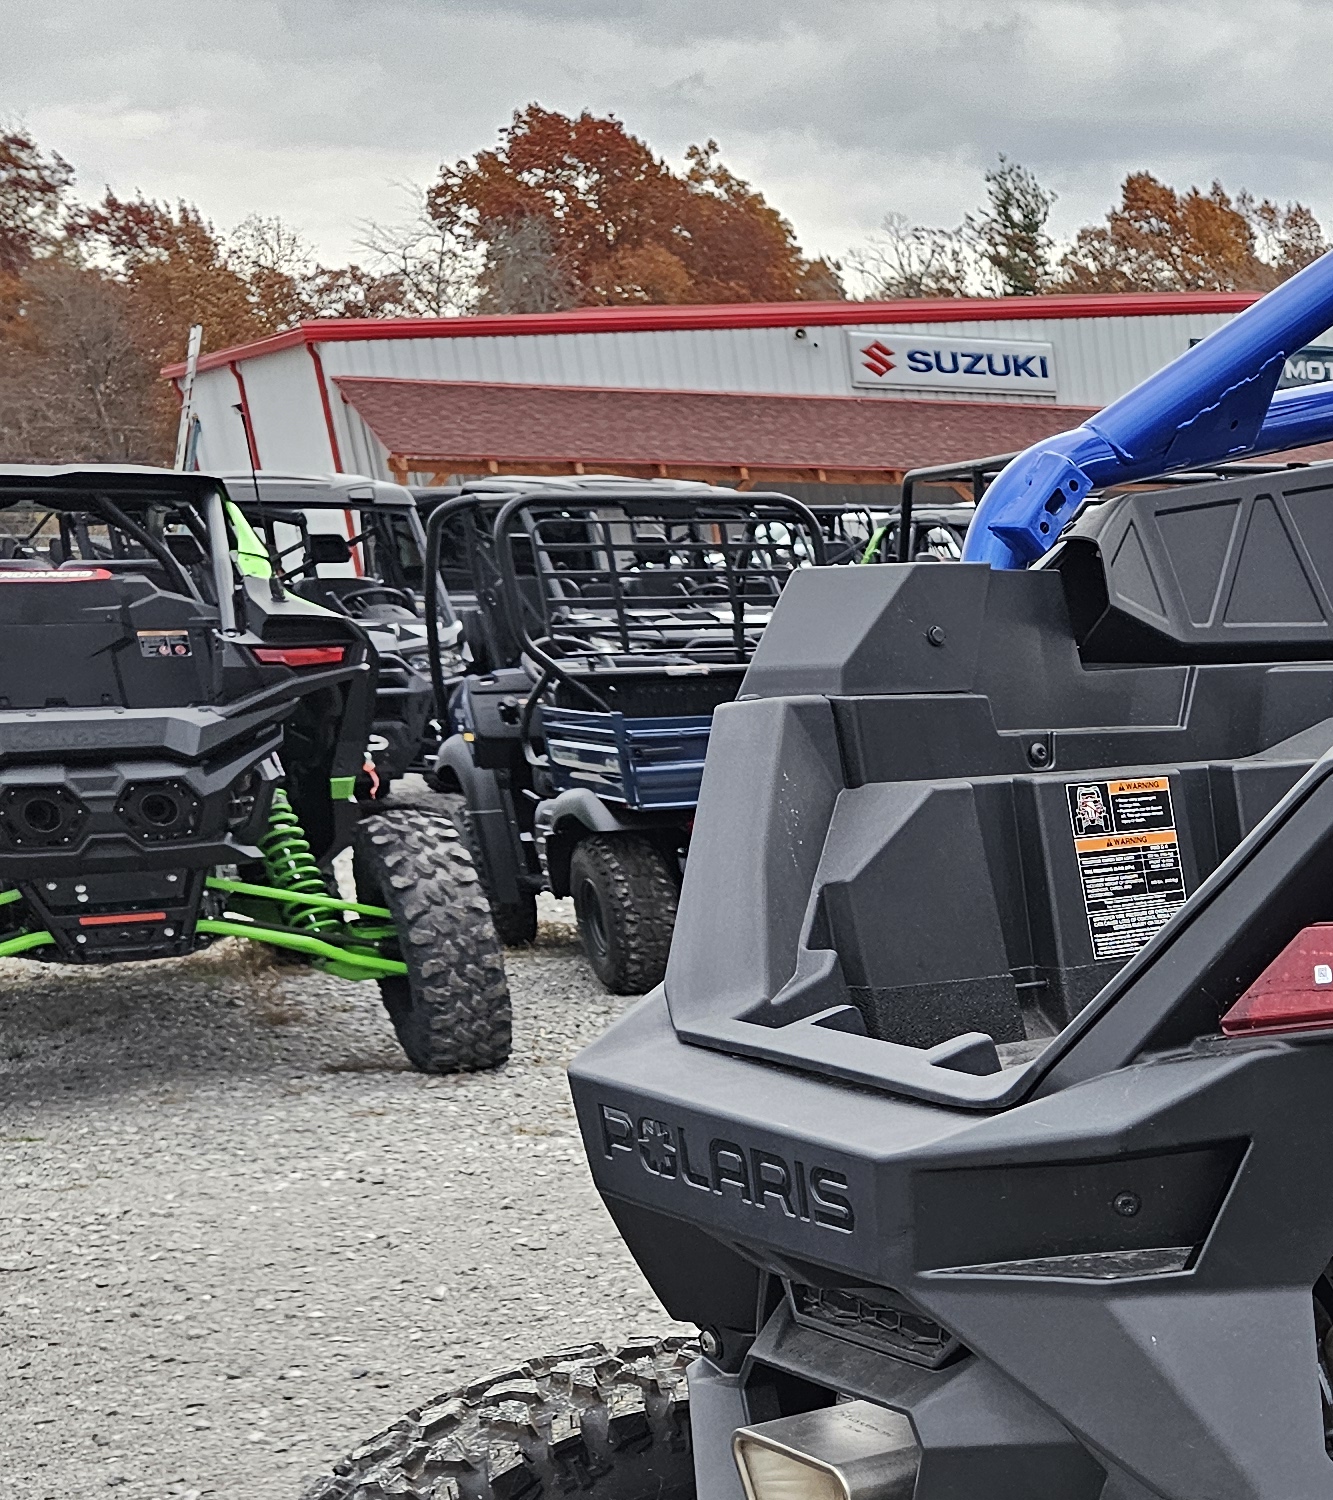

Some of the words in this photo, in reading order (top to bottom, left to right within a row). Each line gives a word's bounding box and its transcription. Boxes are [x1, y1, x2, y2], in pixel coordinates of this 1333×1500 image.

[907, 349, 1050, 380] SUZUKI
[1125, 780, 1160, 790] WARNING
[1113, 835, 1148, 845] WARNING
[598, 1103, 856, 1234] POLARIS
